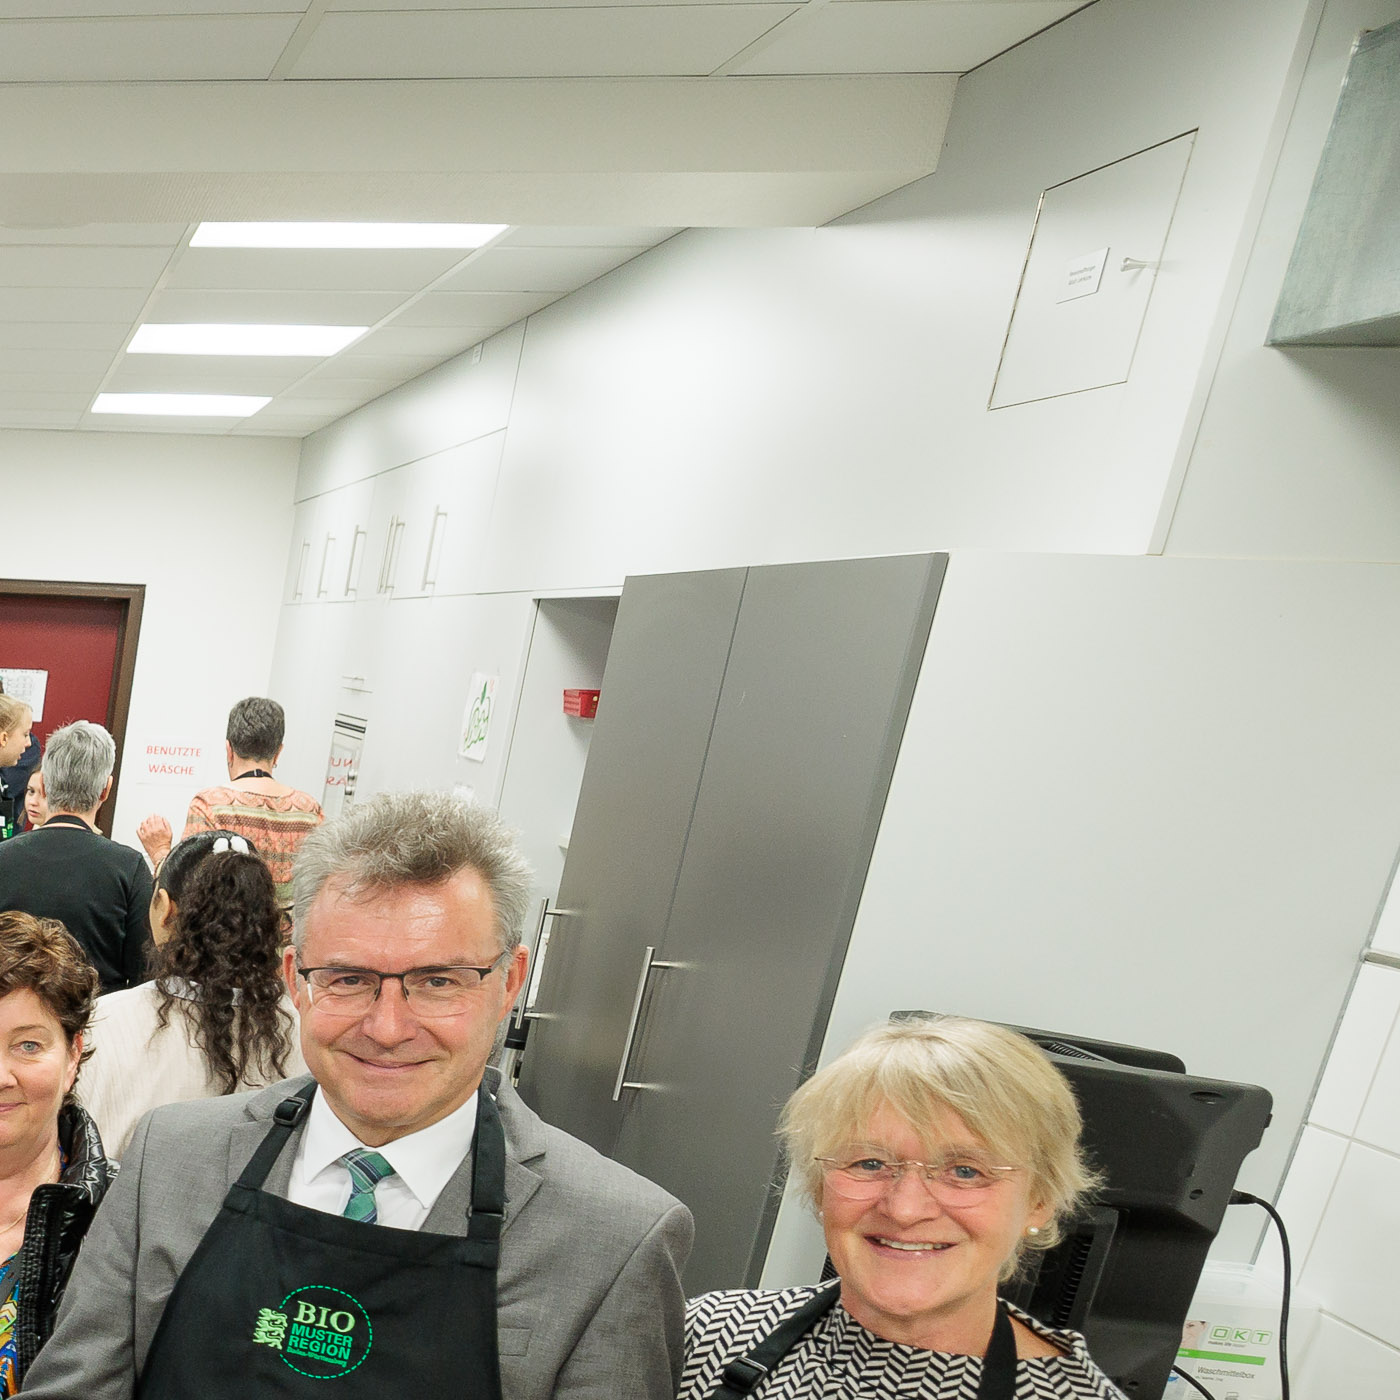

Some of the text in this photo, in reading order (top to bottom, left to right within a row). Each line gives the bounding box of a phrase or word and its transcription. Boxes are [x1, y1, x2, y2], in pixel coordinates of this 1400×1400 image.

[146, 745, 201, 757] BENUTZTE
[293, 1301, 355, 1332] BIO
[289, 1335, 351, 1360] REGION
[292, 1323, 352, 1348] MUSTER
